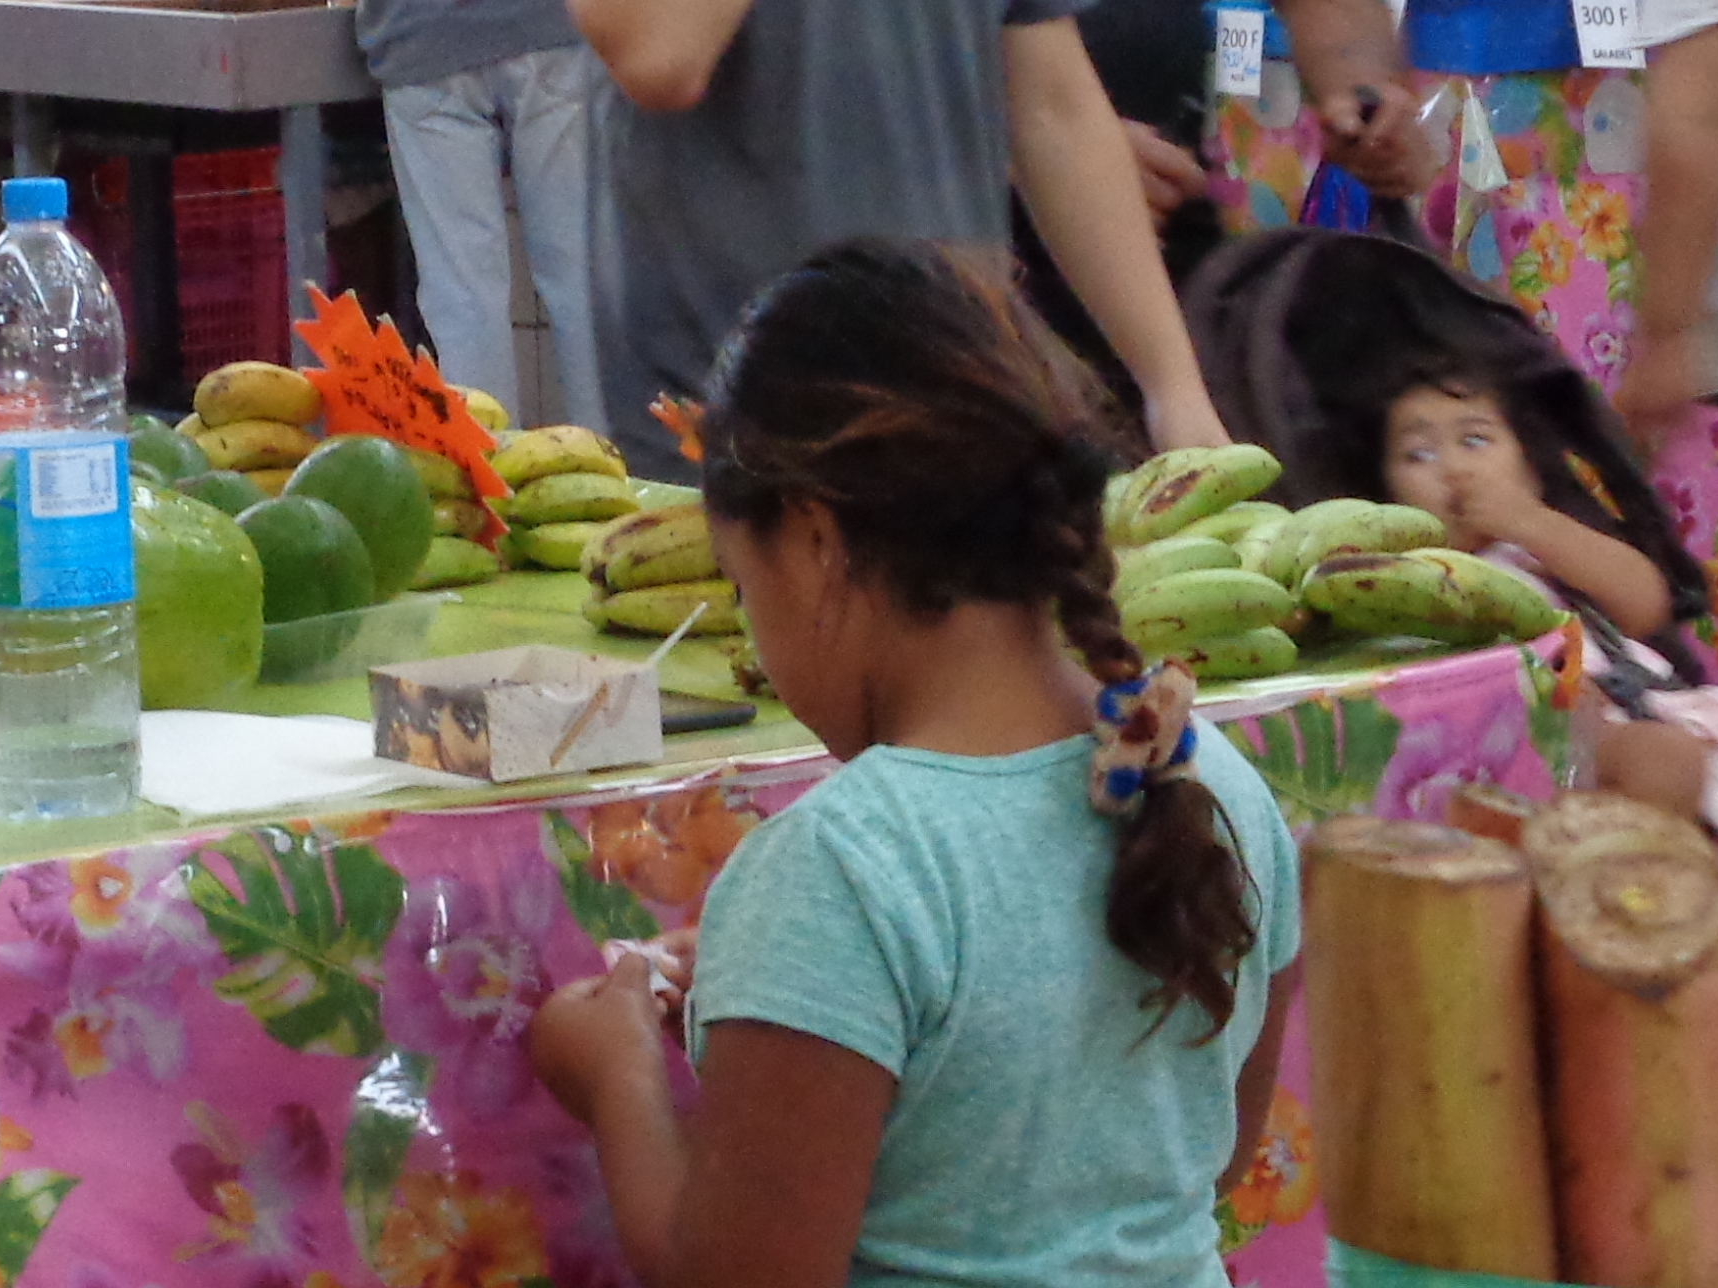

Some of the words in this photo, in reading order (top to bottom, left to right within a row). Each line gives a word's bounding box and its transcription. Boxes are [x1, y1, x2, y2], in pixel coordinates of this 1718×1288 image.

[1582, 5, 1615, 26] 300
[1619, 7, 1629, 27] F
[1222, 27, 1248, 48] 200
[1251, 29, 1259, 50] F
